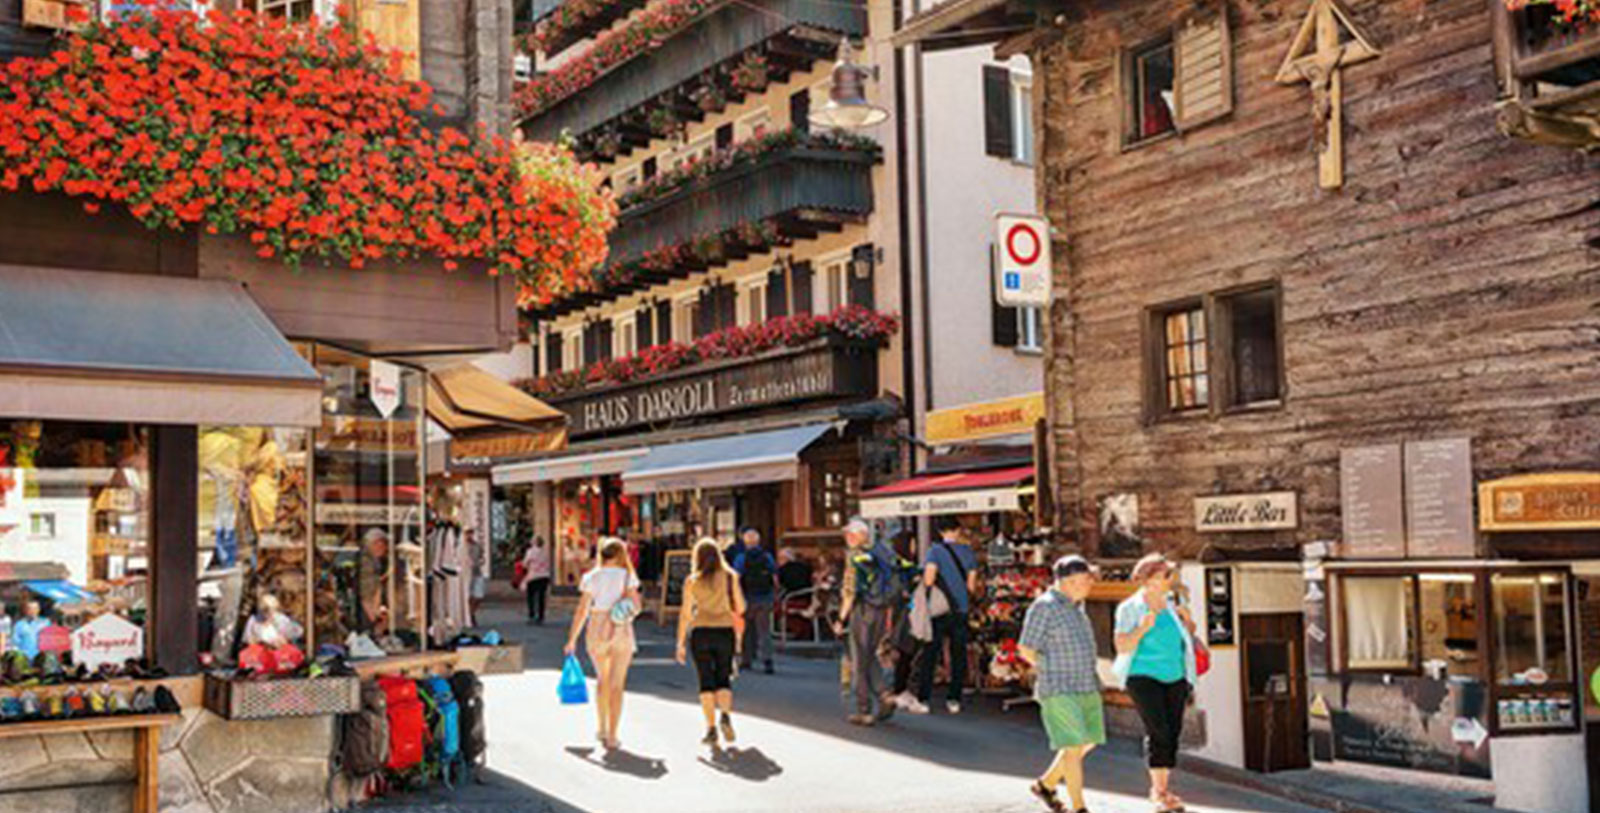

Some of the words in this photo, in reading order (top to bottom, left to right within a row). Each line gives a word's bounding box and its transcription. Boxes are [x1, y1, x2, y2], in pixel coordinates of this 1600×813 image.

[583, 396, 629, 431] HAUS
[637, 379, 716, 422] DARIOLI
[1202, 502, 1247, 524] Little
[1250, 500, 1286, 523] Bar
